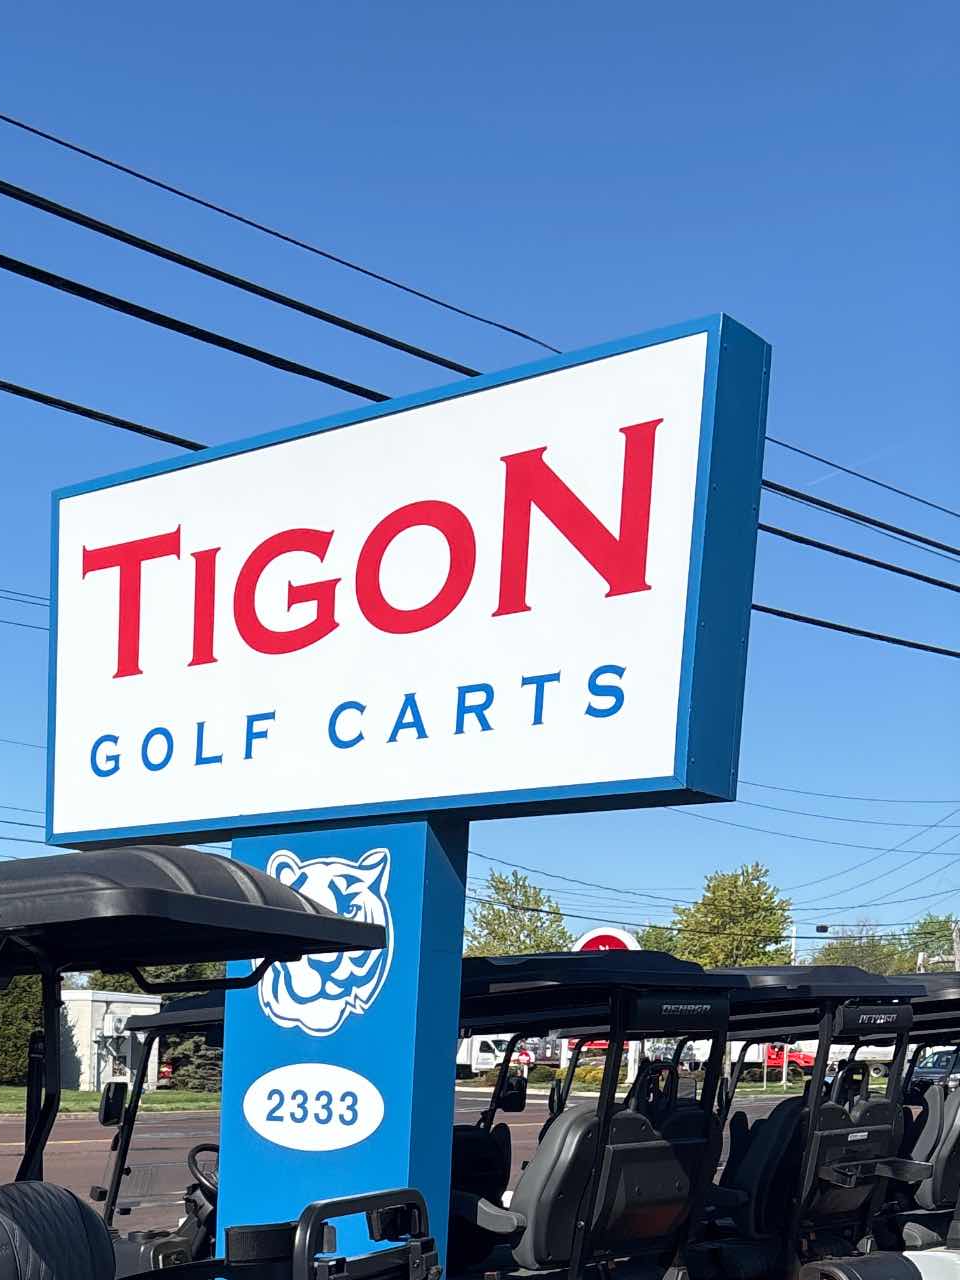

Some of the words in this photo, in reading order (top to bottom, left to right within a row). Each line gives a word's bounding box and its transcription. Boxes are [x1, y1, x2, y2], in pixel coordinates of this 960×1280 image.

[82, 418, 664, 678] TIGON
[91, 710, 276, 778] GOLF
[327, 664, 627, 749] CARTS
[266, 1088, 359, 1126] 2333
